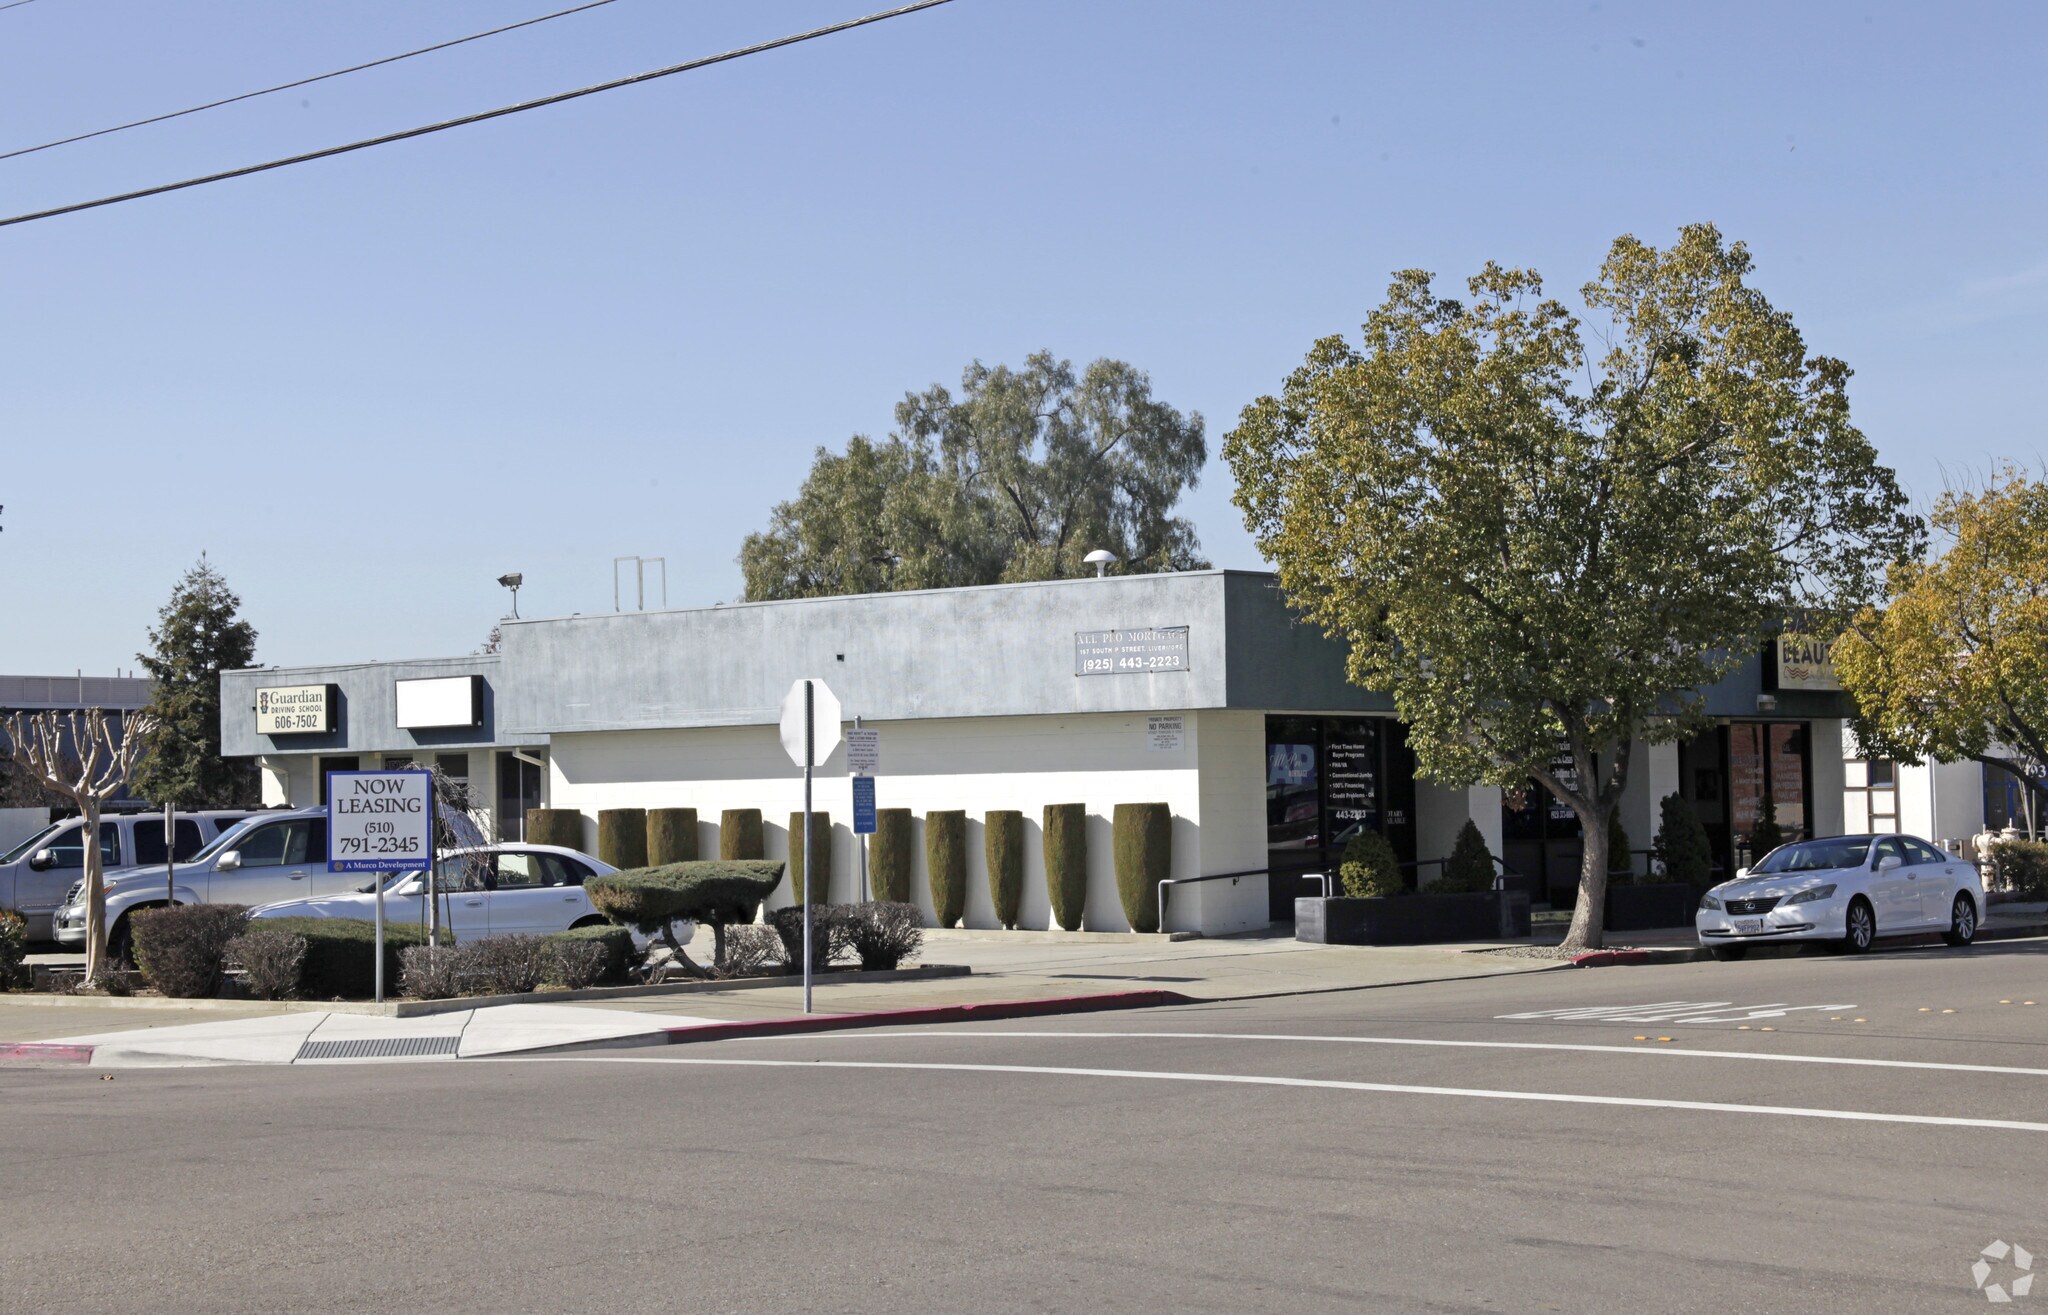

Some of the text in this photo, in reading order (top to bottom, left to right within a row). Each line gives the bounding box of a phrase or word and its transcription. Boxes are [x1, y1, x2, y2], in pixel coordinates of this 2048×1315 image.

[1077, 634, 1098, 645] ALL
[1102, 632, 1123, 643] PRO
[1083, 655, 1180, 673] (925) 443-2223
[270, 690, 322, 704] Guardian
[271, 704, 322, 714] DRIVING SCHOOL
[275, 714, 318, 729] 606-7502
[1148, 722, 1182, 730] NO PARKING
[353, 779, 405, 795] NOW
[337, 797, 422, 814] LEASING
[364, 821, 395, 836] (510)
[340, 836, 419, 854] 791-2345
[353, 861, 377, 869] Murco
[378, 861, 426, 870] Development
